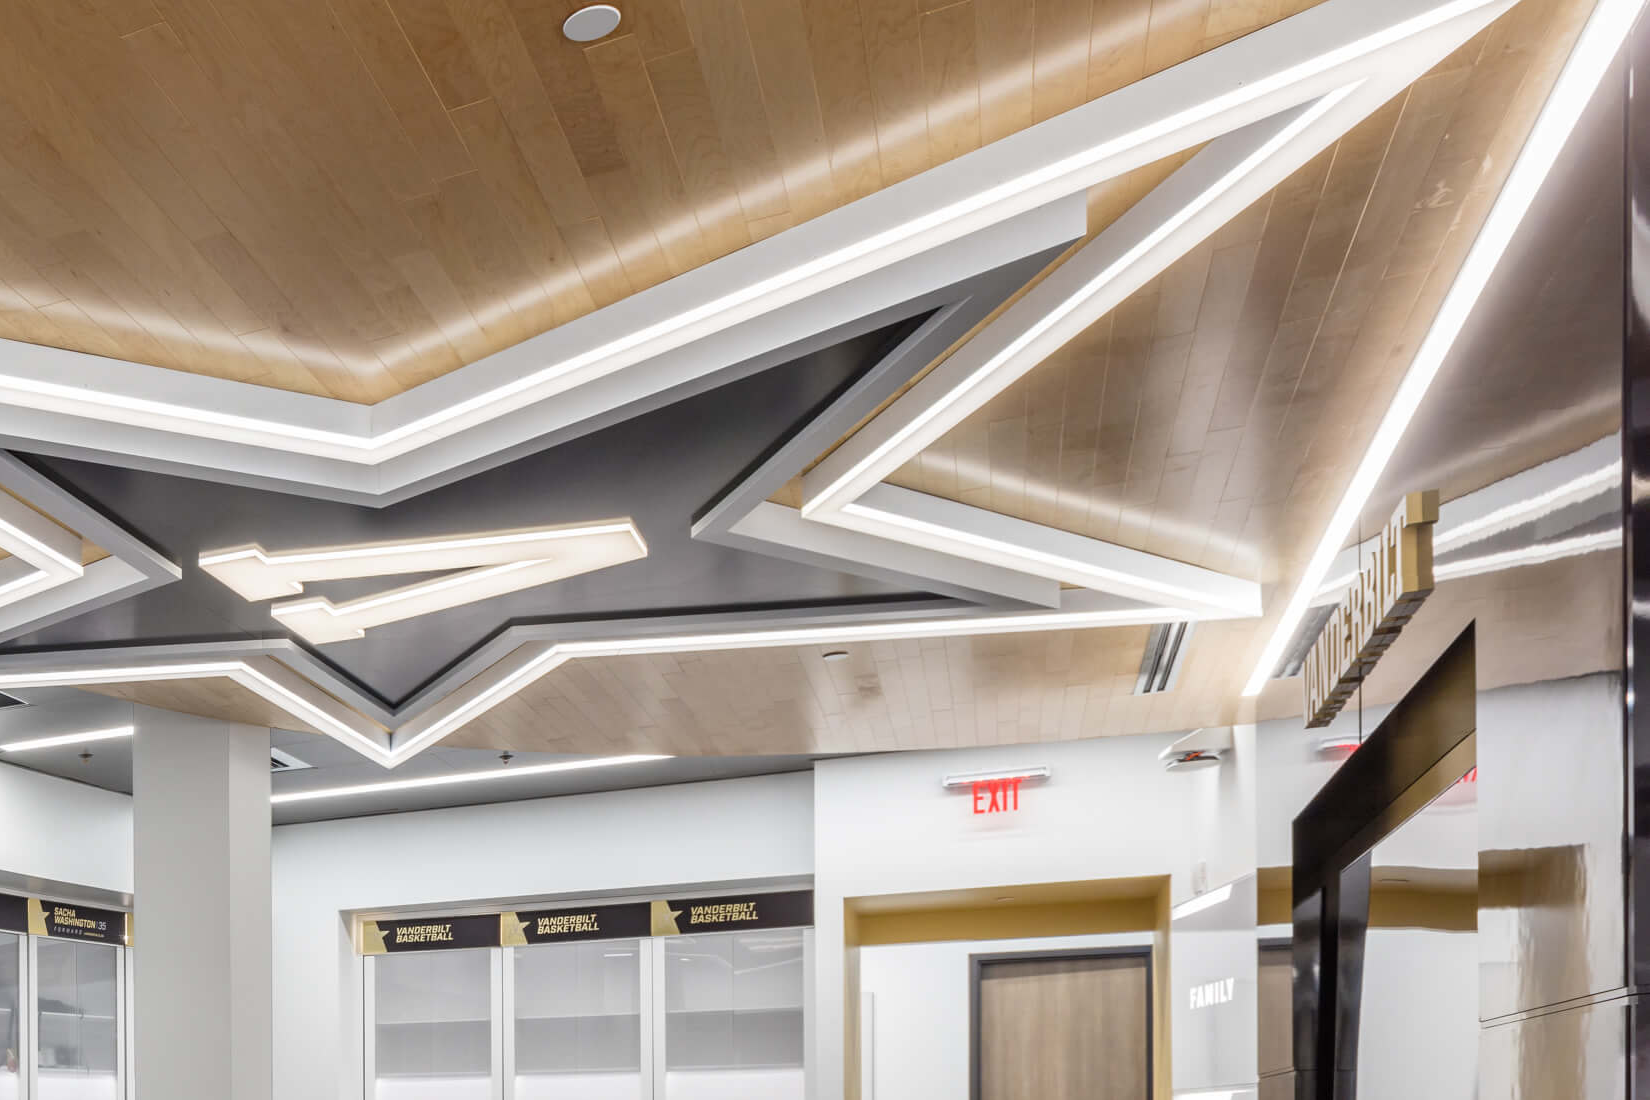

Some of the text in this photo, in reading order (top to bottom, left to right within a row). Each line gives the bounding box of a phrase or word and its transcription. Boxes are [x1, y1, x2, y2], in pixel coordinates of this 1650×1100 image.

[1303, 488, 1439, 729] VANDERBILT
[972, 778, 1022, 814] EXIT
[54, 907, 76, 917] SACHA
[691, 902, 756, 914] VANDERBILT
[54, 916, 107, 930] WASHINGTON 35
[538, 914, 597, 926] VANDERBILT
[691, 911, 758, 924] BASKETBALL
[397, 924, 451, 935] VANDERBILT
[537, 922, 599, 934] BASKETBALL
[396, 932, 454, 943] BASKETBALL
[1190, 977, 1234, 1009] FAMILY
